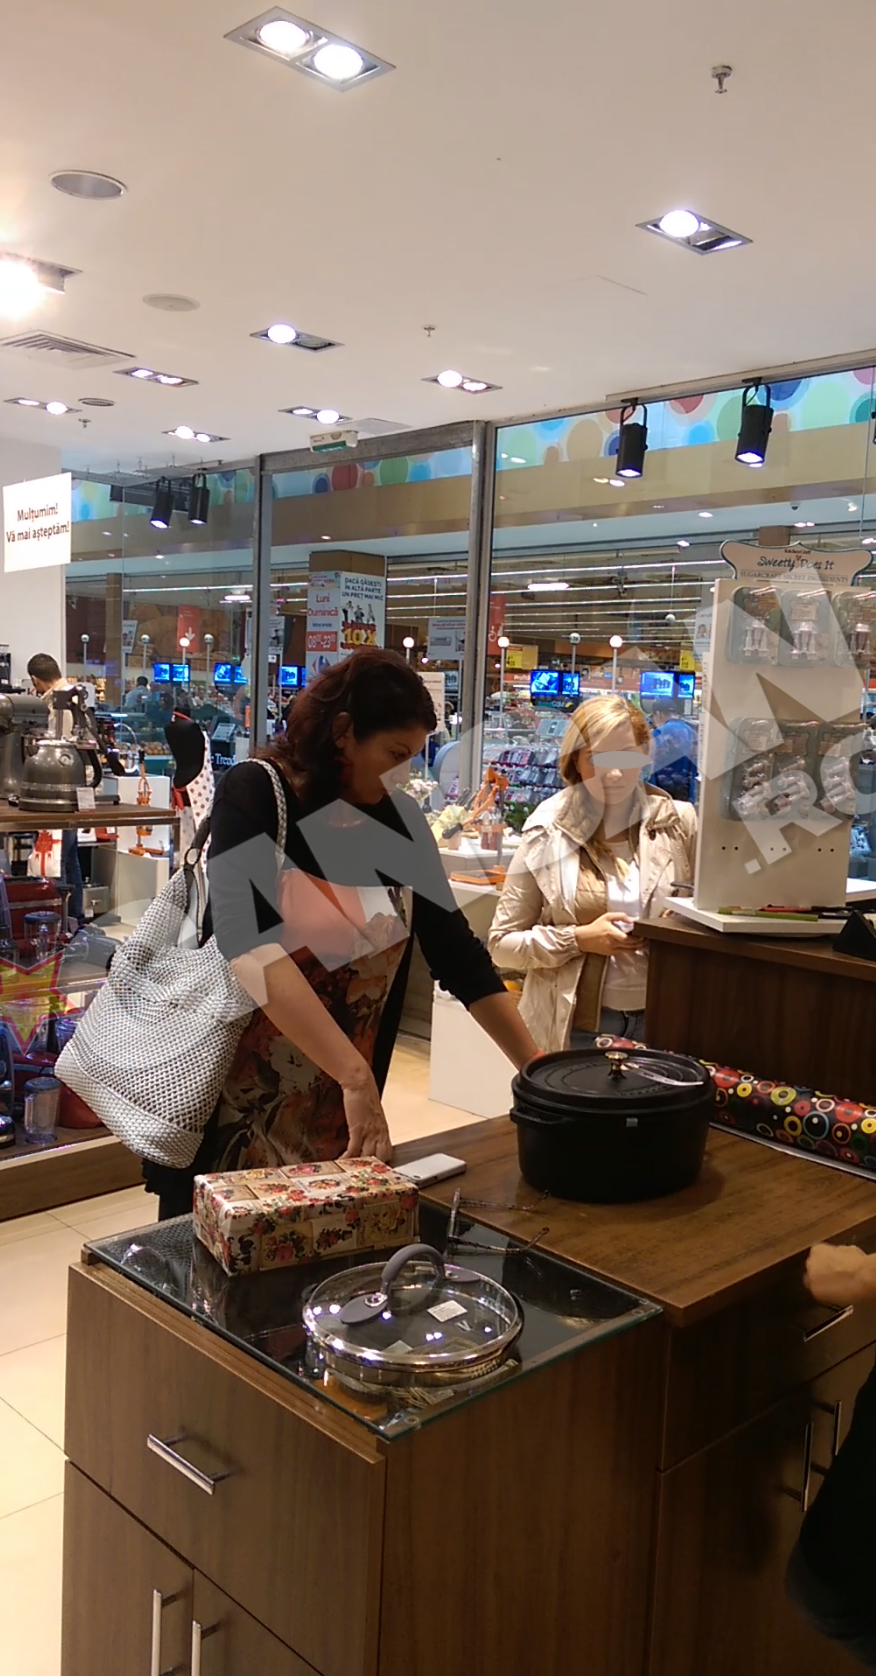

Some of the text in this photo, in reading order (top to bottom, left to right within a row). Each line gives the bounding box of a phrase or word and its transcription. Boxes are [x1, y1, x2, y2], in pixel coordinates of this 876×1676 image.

[17, 502, 58, 522] Mulțumim!
[6, 530, 16, 543] Vă
[17, 527, 31, 541] mai
[757, 556, 796, 571] Sweetly
[824, 559, 835, 570] It
[316, 593, 330, 603] Luni
